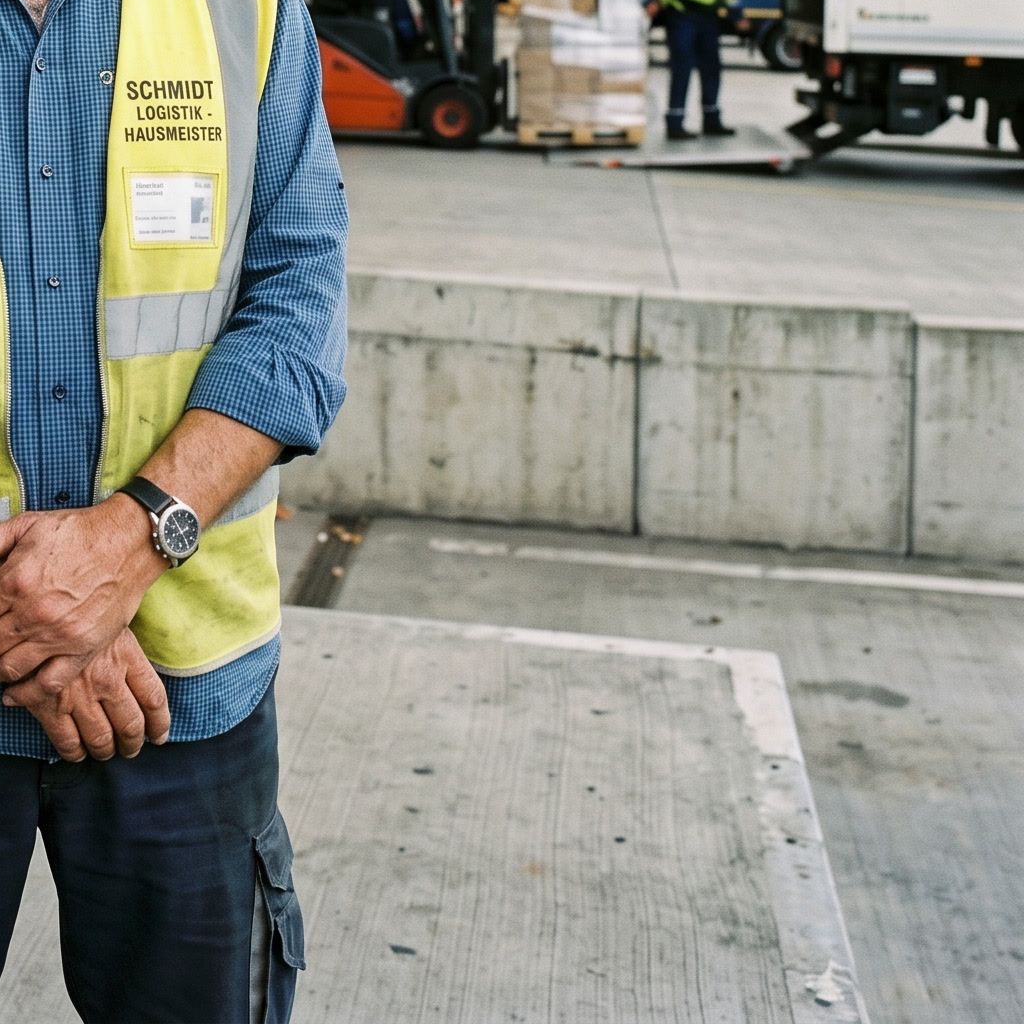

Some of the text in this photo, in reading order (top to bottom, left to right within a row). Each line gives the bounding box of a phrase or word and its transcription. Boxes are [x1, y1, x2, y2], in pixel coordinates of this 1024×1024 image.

[126, 80, 214, 101] SCHMIDT
[136, 105, 203, 121] LOGISTIK
[124, 126, 222, 143] HAUSMEISTER
